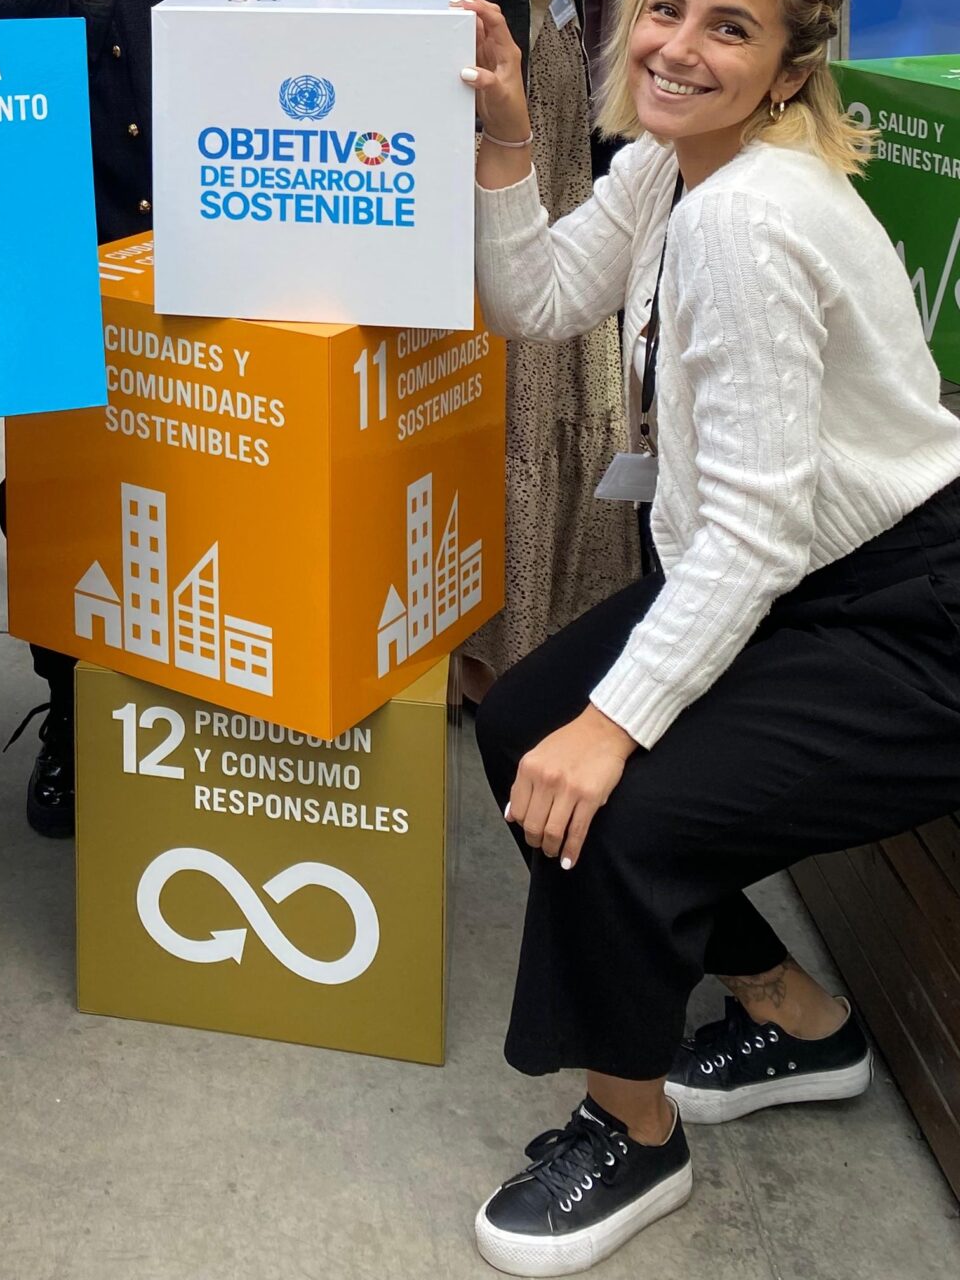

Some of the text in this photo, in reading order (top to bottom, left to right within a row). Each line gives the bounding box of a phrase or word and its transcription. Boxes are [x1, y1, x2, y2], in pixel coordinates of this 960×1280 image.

[198, 126, 416, 166] OBJETIVOS
[878, 110, 945, 144] SALUD Y
[201, 166, 415, 195] DE DESARROLLO
[877, 139, 960, 180] BIENESTAR
[200, 191, 415, 227] SOSTENIBLE
[104, 324, 251, 377] CIUDADES Y
[397, 331, 490, 401] COMUNIDADES
[106, 365, 286, 428] COMUNIDADES
[353, 340, 388, 431] 11
[397, 372, 483, 441] SOSTENIBLES
[105, 405, 270, 467] SOSTENIBLES
[112, 702, 186, 780] 12
[194, 748, 361, 790] Y CONSUMO
[194, 785, 409, 834] RESPONSABLES
